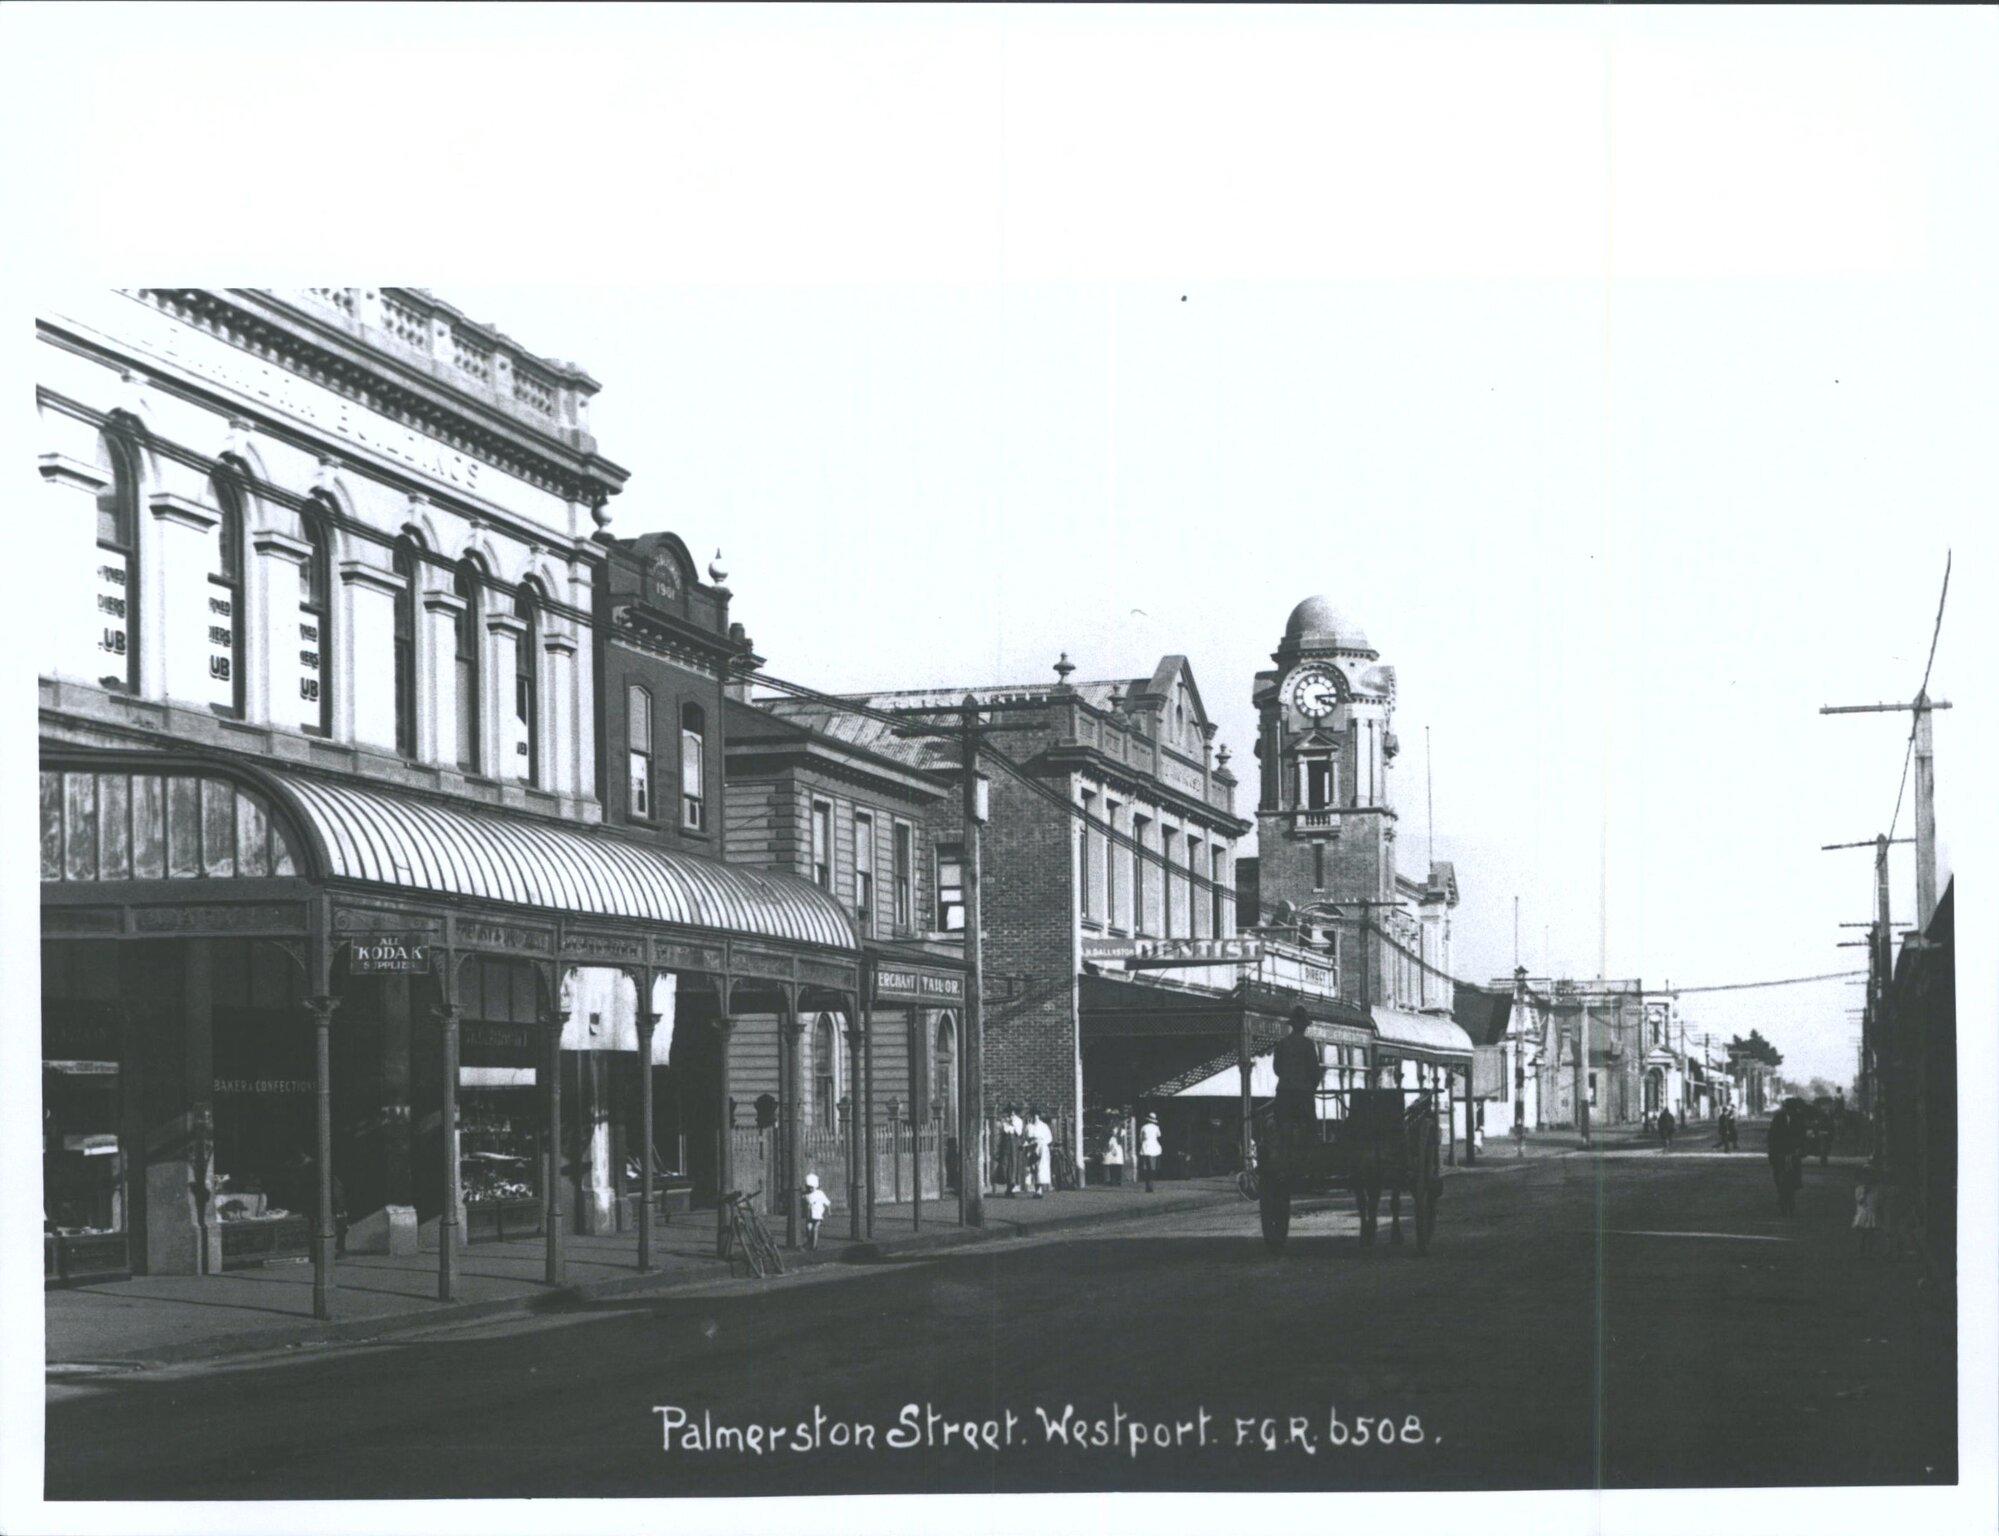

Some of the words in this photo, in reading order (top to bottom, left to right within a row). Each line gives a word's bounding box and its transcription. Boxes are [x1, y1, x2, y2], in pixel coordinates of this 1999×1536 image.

[98, 627, 126, 656] UB
[1135, 940, 1260, 960] DENTIST
[871, 971, 916, 990] ERCHANT
